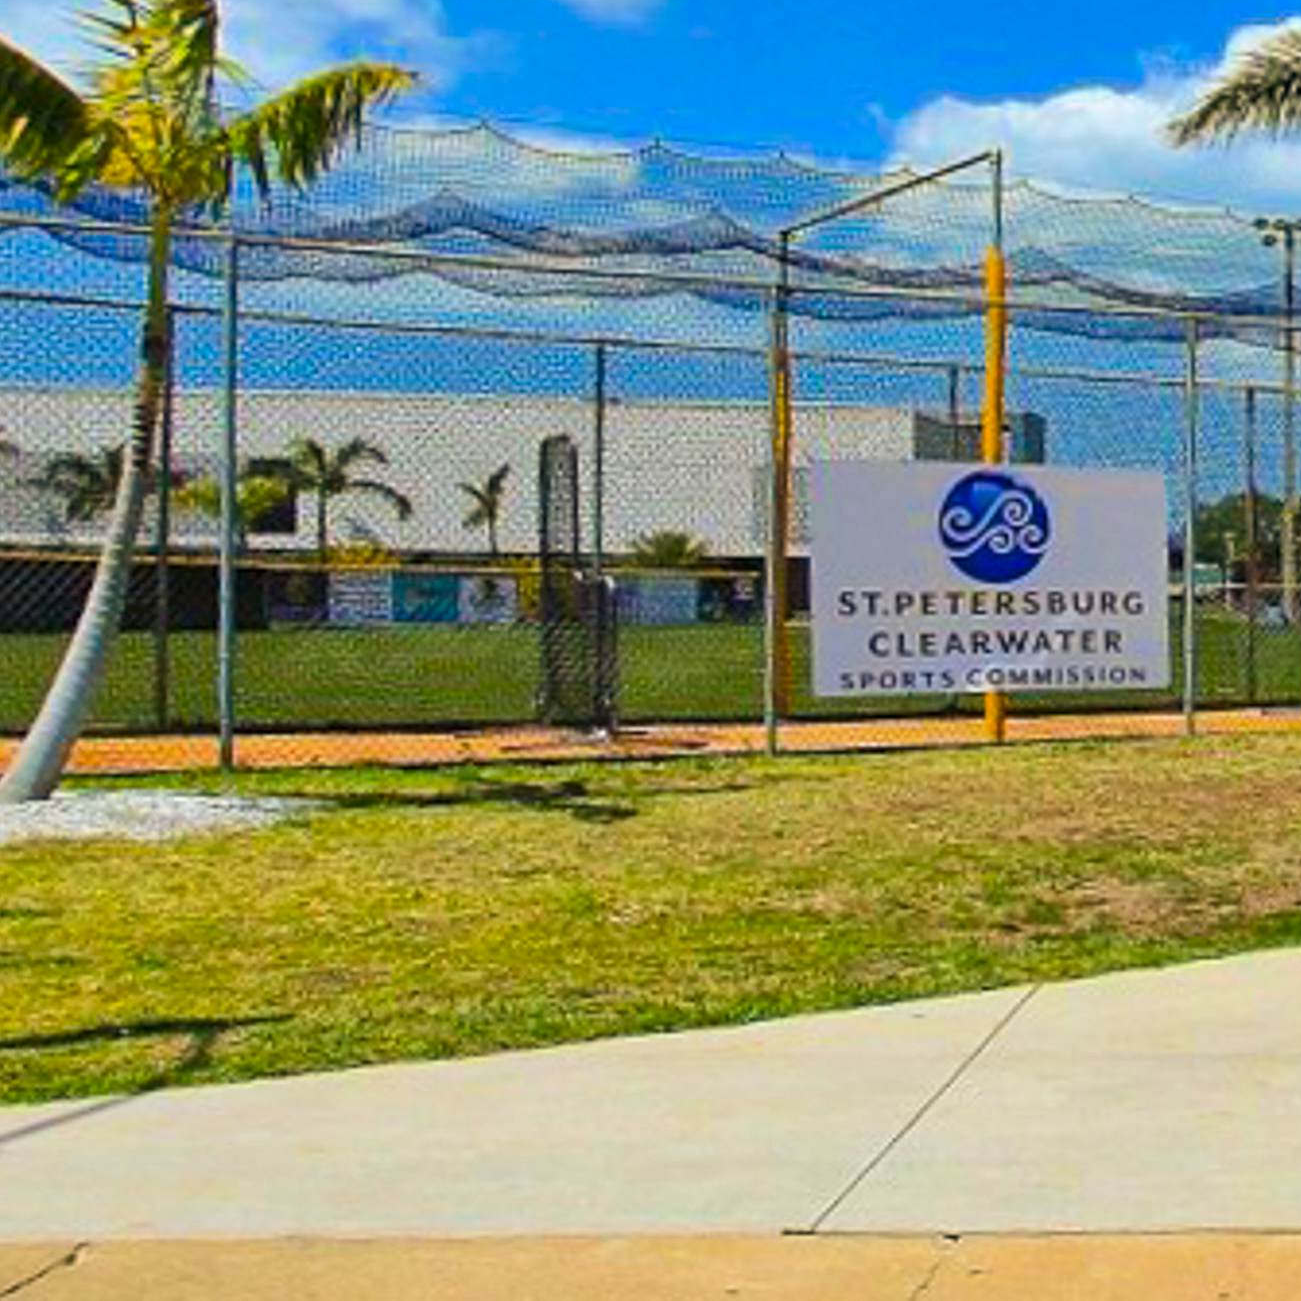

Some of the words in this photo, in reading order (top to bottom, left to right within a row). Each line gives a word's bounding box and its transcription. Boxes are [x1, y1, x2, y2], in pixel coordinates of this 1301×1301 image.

[868, 629, 1124, 658] CLEARWATER
[840, 670, 956, 690] SPORTS
[965, 665, 1147, 687] COMMISSION
